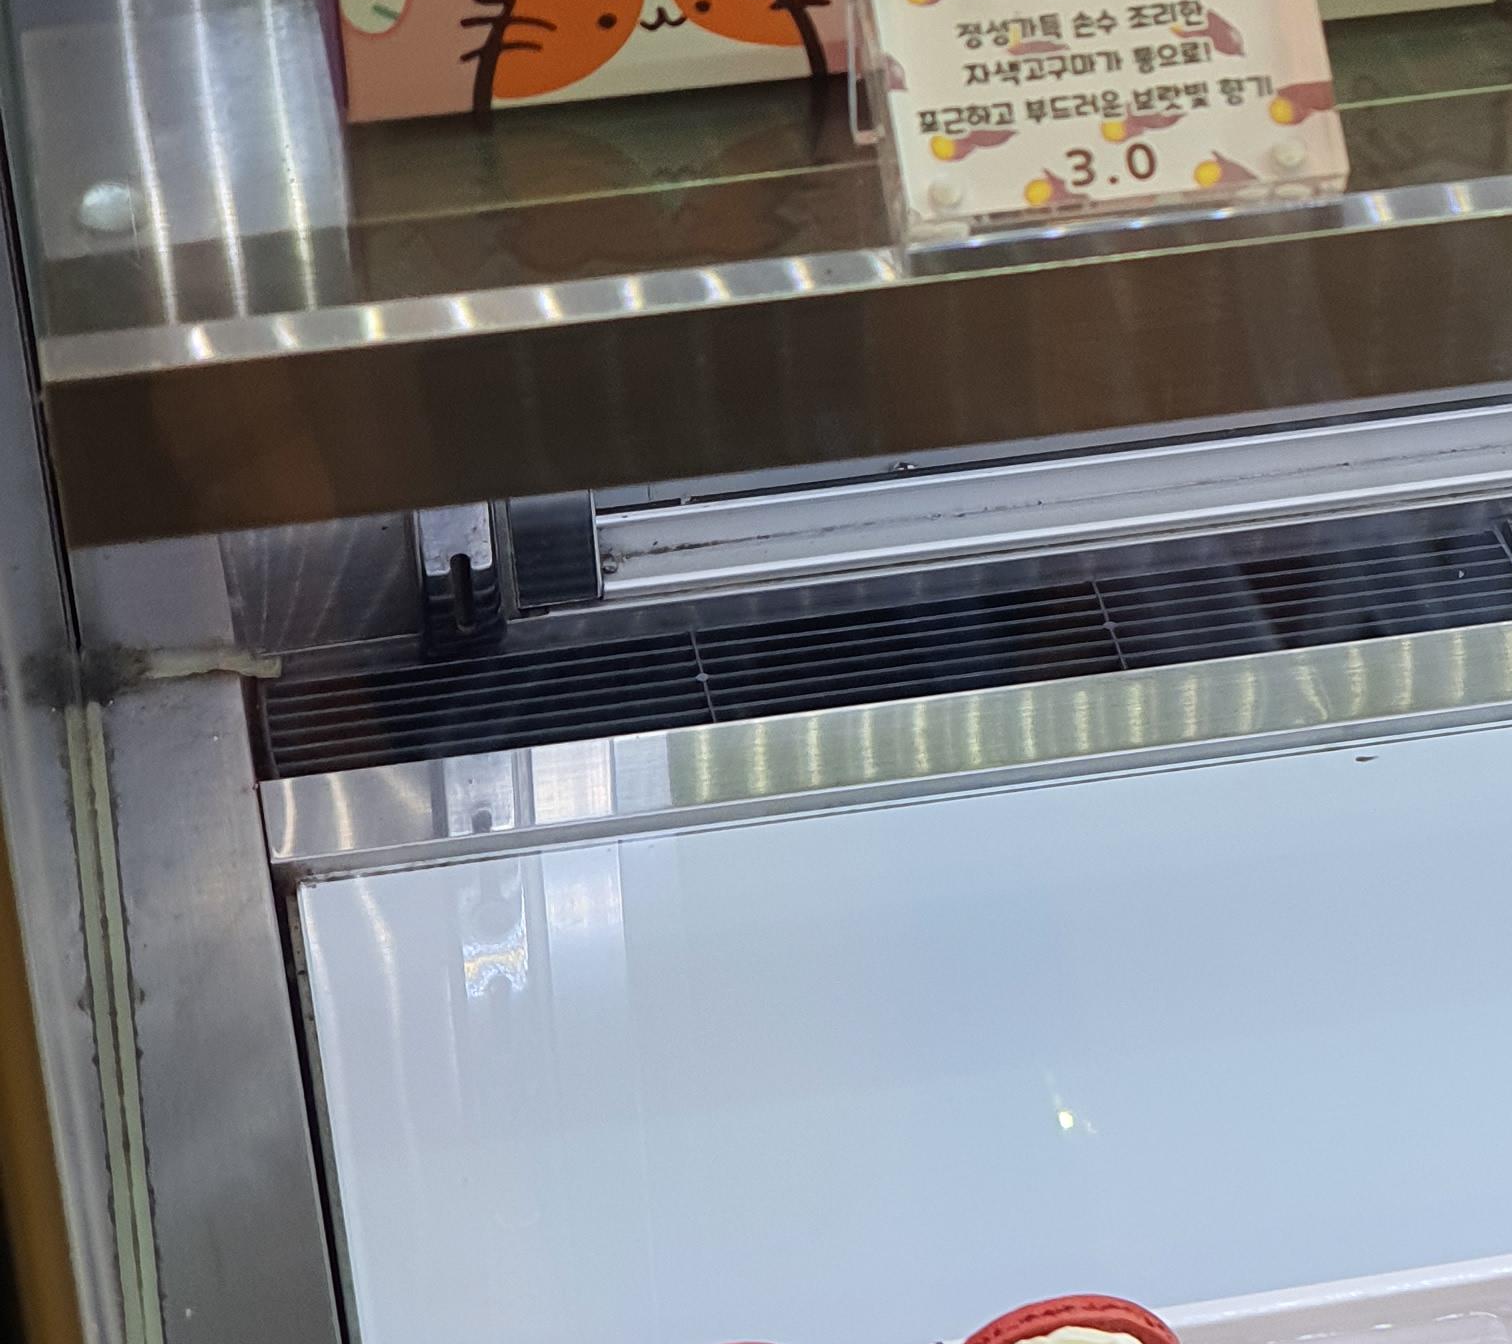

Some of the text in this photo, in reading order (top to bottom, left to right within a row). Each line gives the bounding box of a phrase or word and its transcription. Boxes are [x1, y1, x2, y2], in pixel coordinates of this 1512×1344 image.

[956, 0, 1204, 50] 정성가득 손수 조리한
[962, 40, 1213, 87] 자색고구마가 통으로!
[917, 74, 1275, 135] 포근하고 부드러운 보랏빛 향기
[1064, 141, 1158, 188] 3.0
